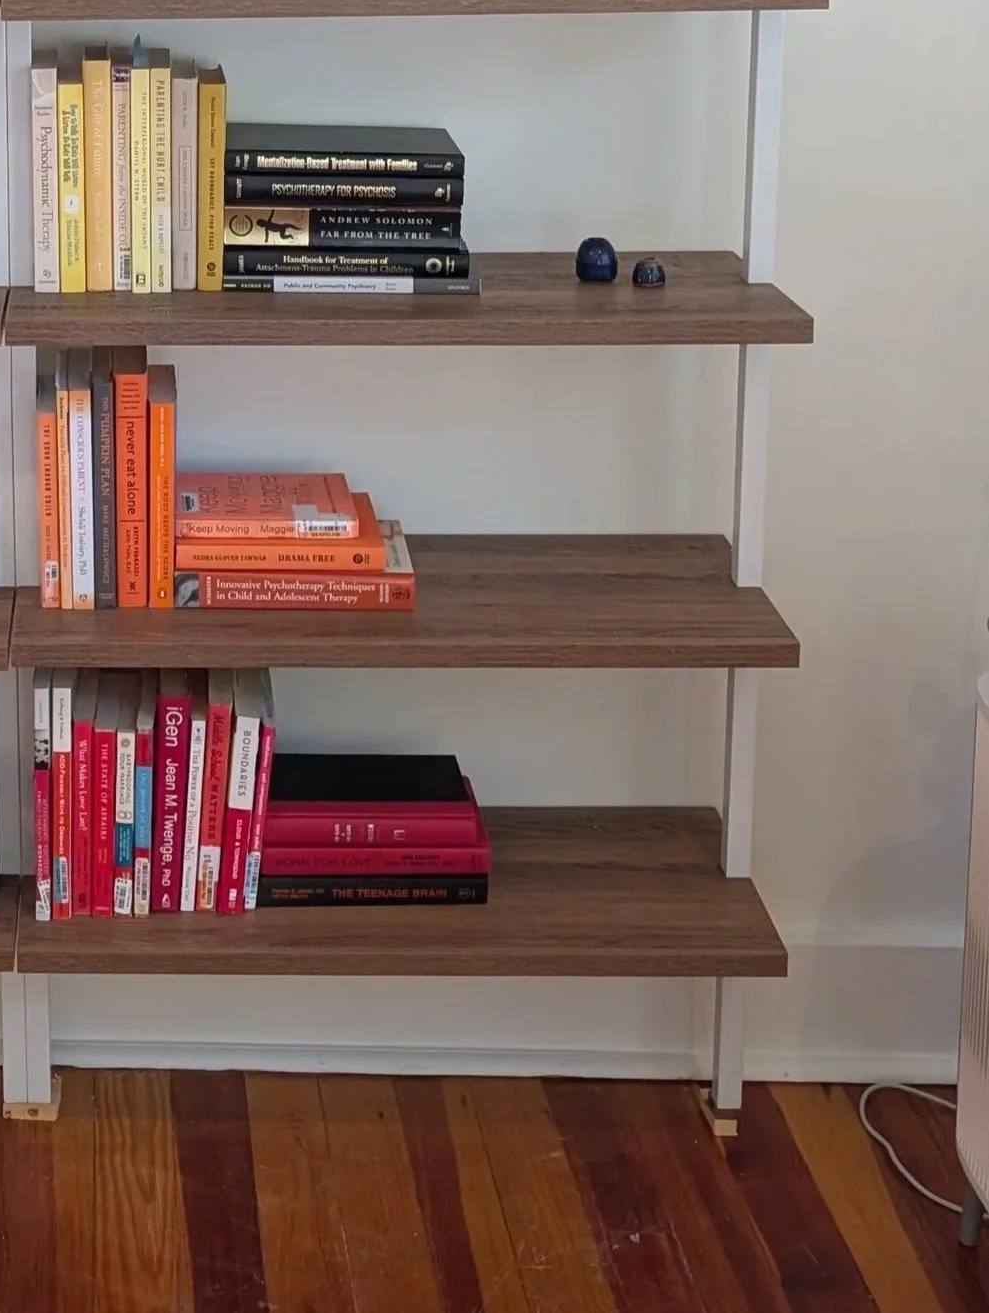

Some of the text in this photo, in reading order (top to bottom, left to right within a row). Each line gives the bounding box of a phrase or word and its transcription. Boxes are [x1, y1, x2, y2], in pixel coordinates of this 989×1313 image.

[92, 79, 104, 178] The Gift of Failure
[156, 79, 166, 203] PARENTING THE HURT CHILD
[256, 155, 418, 171] Mentalization-Based Treatment with Families
[36, 126, 54, 253] Psychodynamic Therapy
[272, 183, 396, 199] PSYCHOTHERAPY FOR PSYCHOSIS
[320, 216, 433, 225] ANDREW SOLOMON
[320, 230, 431, 240] FAR FROM THE TREE
[255, 263, 414, 273] Attachment-Trauma Problems in Children
[283, 255, 389, 265] Handbook for Treatment of
[76, 399, 85, 491] THE CONSCIOUS PARENT
[100, 413, 110, 465] PUMPKIN
[125, 421, 135, 455] never
[126, 458, 136, 477] eat
[101, 467, 110, 496] PLAN
[127, 481, 138, 515] alone
[188, 525, 249, 535] Keep Moving
[260, 525, 295, 535] Maggie
[278, 554, 335, 563] DRAMA FREE
[216, 579, 376, 593] Innovative Psychotherapy Techniques
[216, 591, 358, 603] in Child and Adolescent Therapy
[237, 731, 252, 797] BOUNDARIES
[207, 712, 228, 839] Middle School MATTERS
[78, 740, 88, 831] What Makes Love Last?
[100, 743, 108, 840] THE STATE OF AFFAIRS
[160, 706, 183, 886] iGen Jean M. Twenge, PhD
[275, 856, 372, 867] BORN FOR LOVE
[332, 889, 447, 899] THE TEENAGE BRAIN
